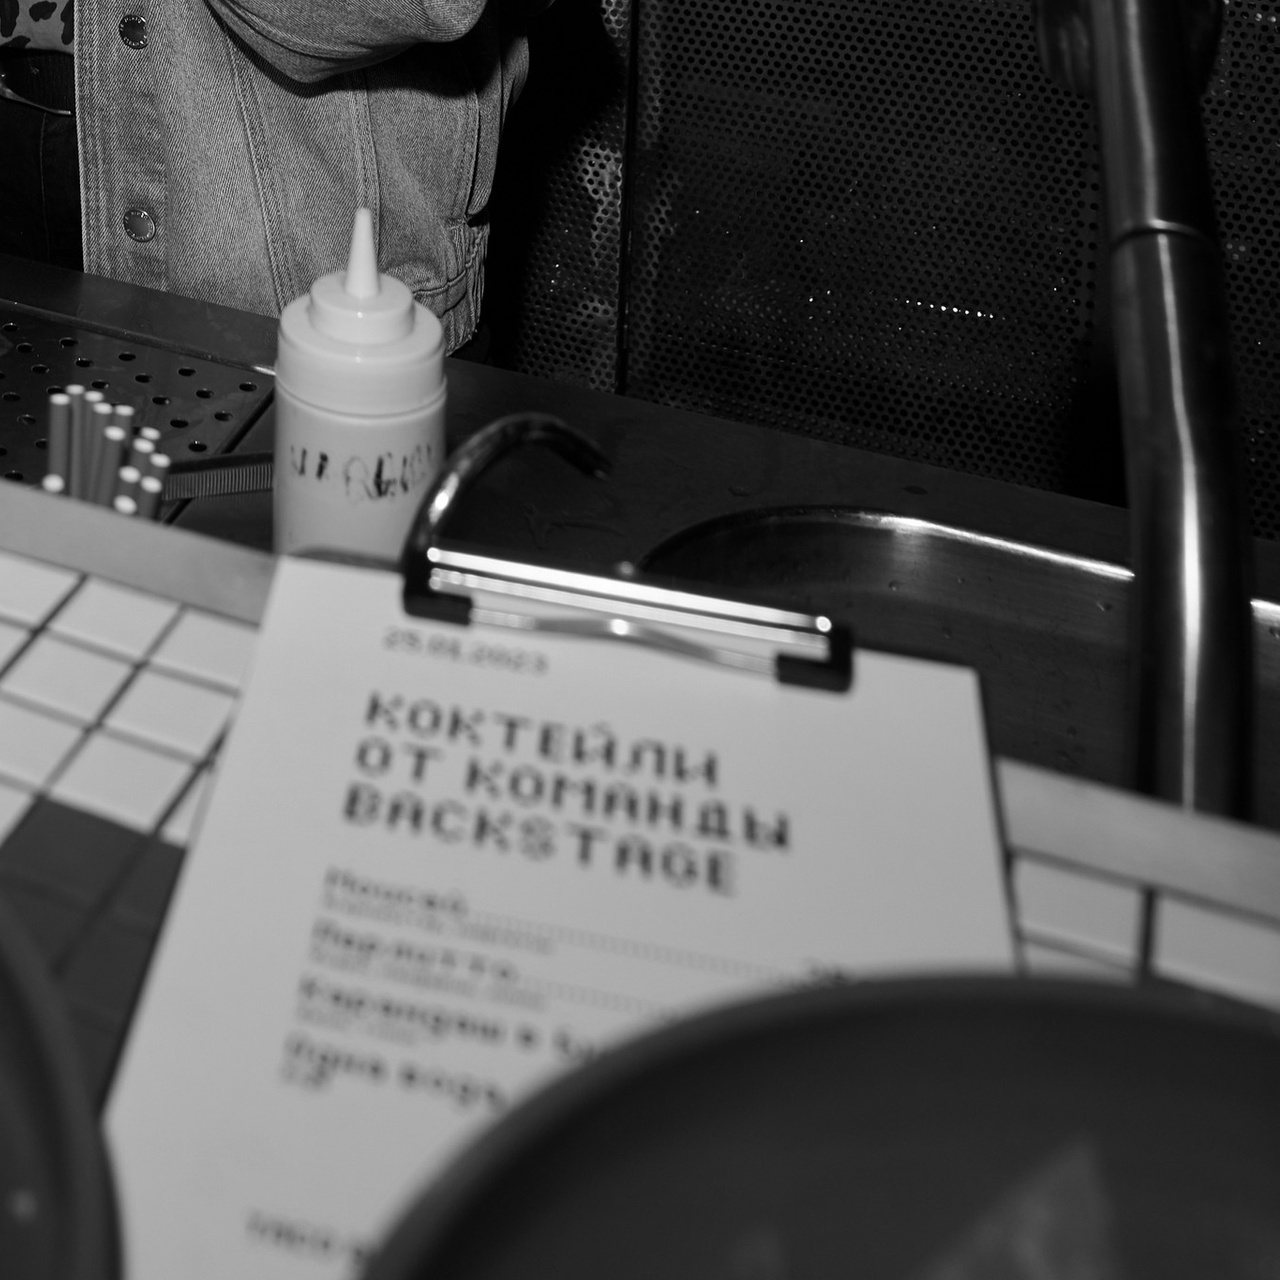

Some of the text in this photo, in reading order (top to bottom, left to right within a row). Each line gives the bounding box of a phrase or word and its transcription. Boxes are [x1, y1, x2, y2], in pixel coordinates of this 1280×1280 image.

[354, 734, 794, 858] ОТ КОМАНДЫ
[363, 688, 721, 792] КОКТЕЙЛИ
[341, 778, 741, 900] BACKSTAGE
